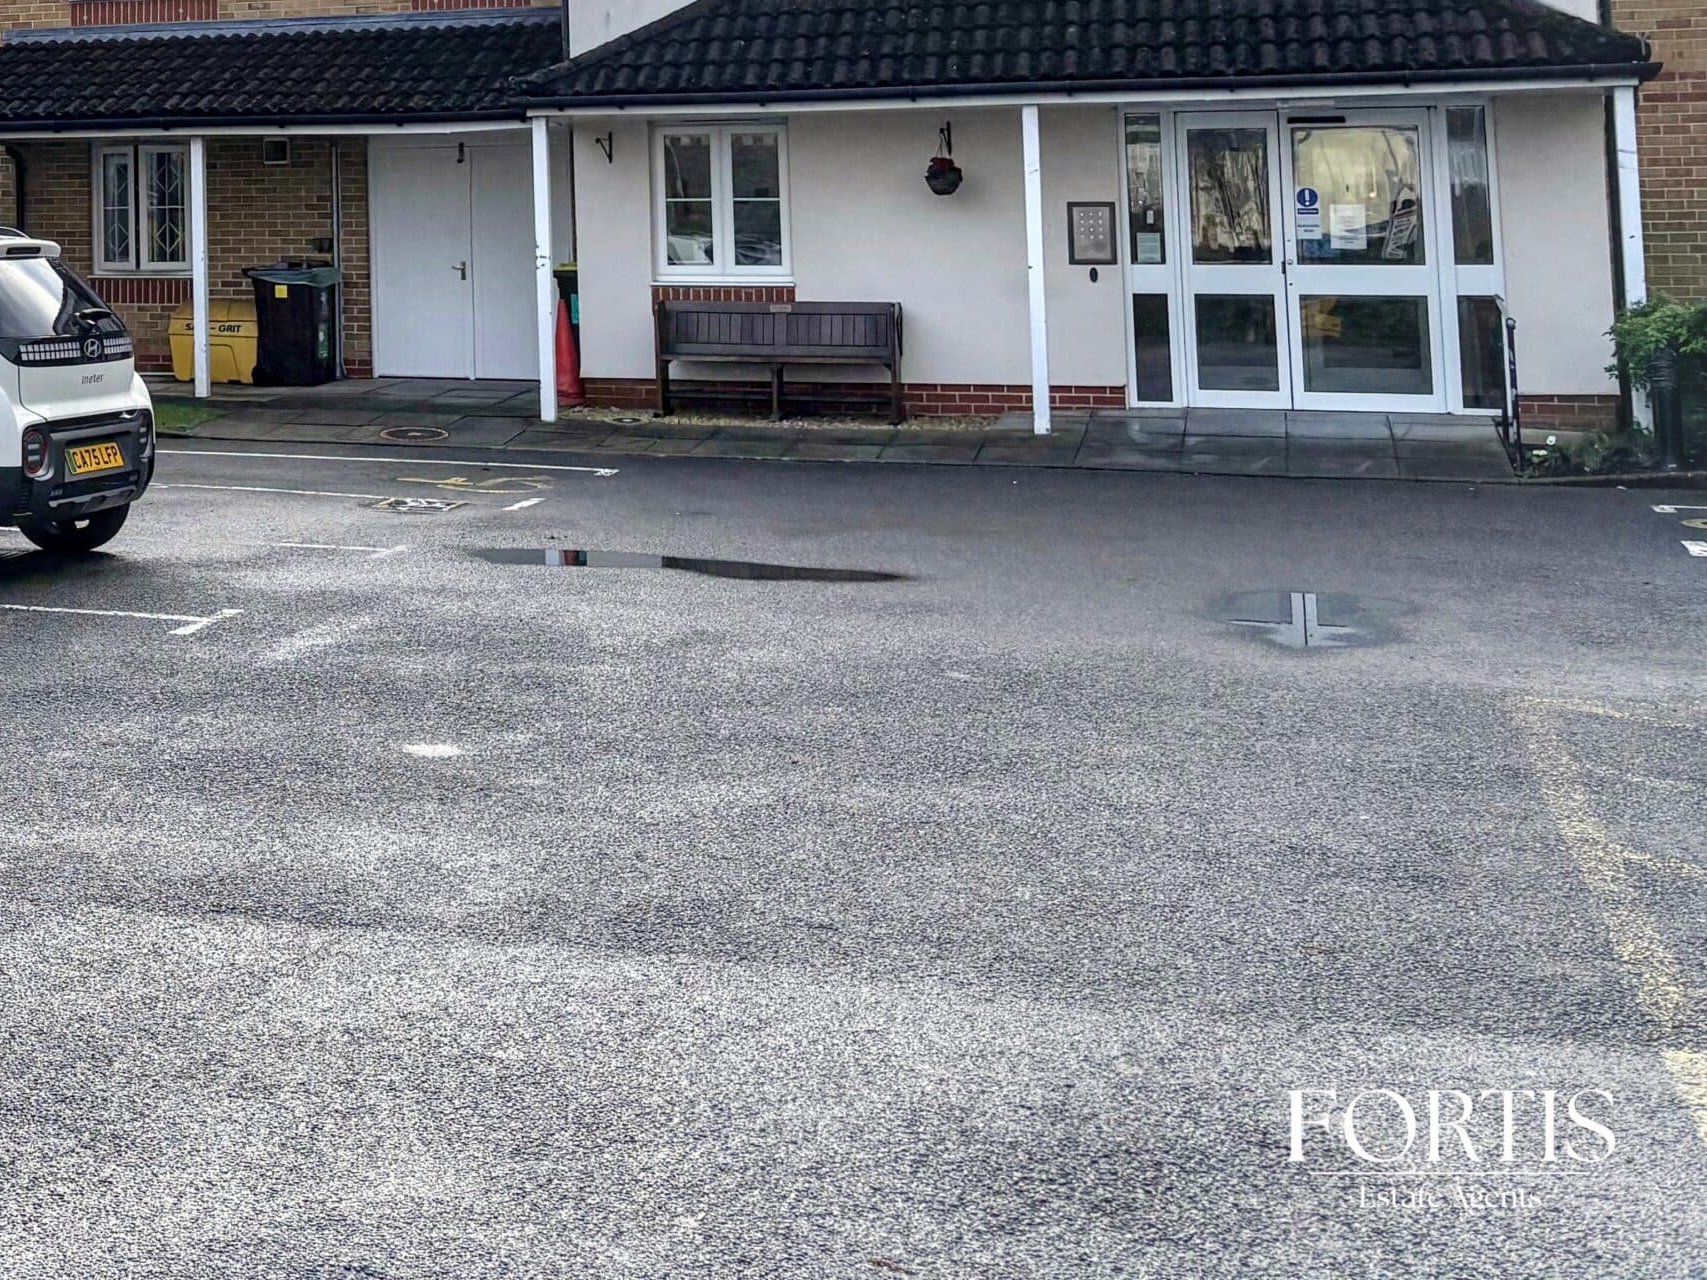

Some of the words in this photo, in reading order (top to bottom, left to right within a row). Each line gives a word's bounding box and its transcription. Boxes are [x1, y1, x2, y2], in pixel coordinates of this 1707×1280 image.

[218, 324, 242, 333] GRIT
[72, 448, 101, 469] CA75
[99, 446, 118, 465] LFP
